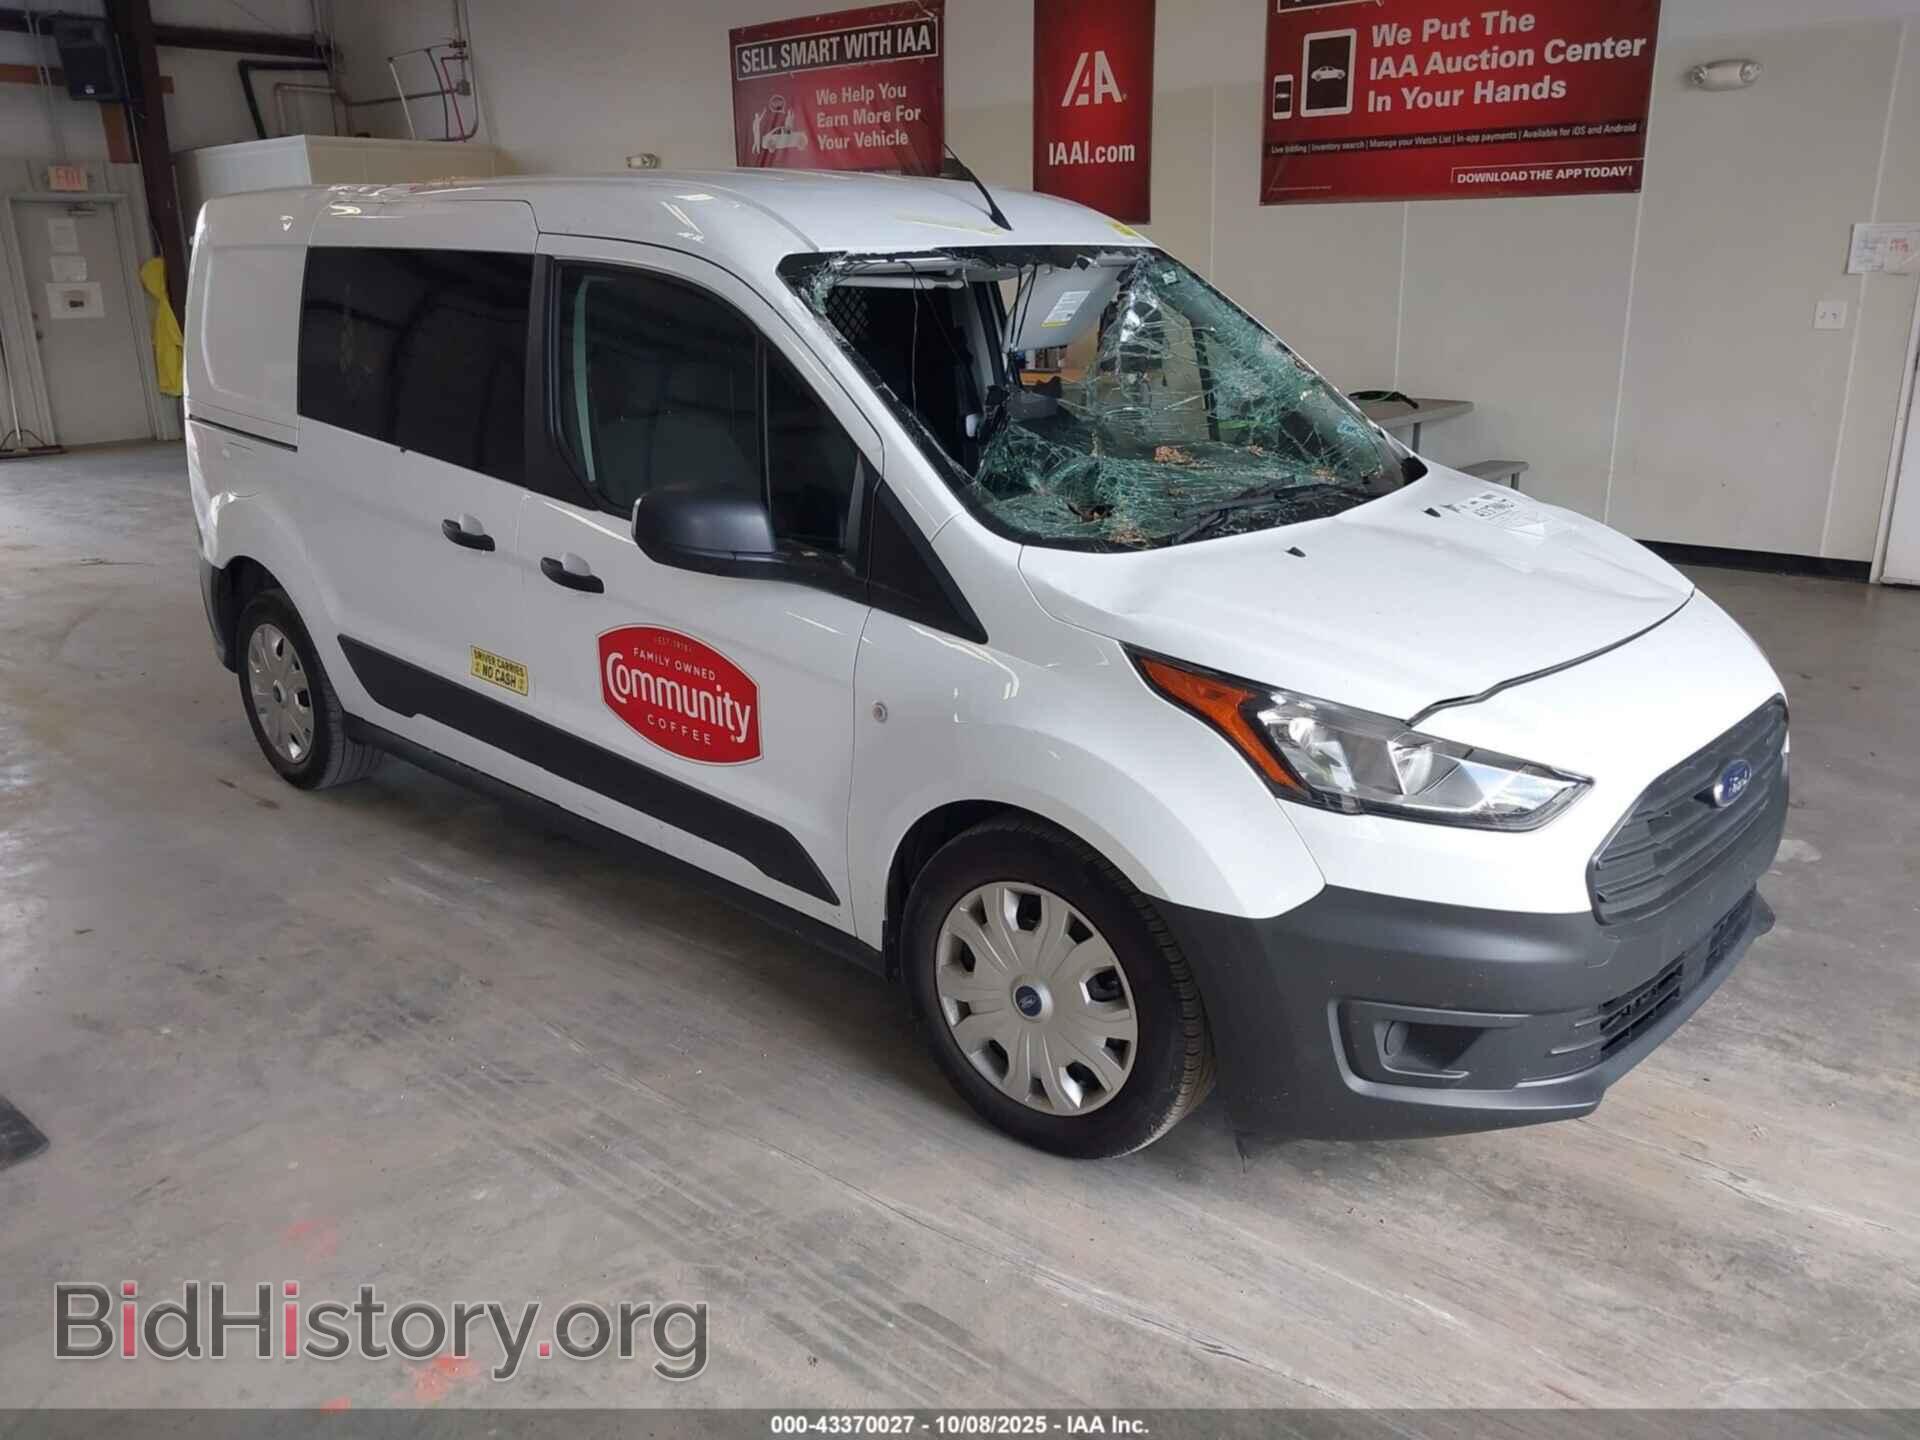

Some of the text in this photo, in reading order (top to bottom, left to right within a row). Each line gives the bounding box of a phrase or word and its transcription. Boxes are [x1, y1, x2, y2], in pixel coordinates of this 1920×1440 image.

[1372, 10, 1536, 48] We Put The
[742, 24, 932, 74] SELL SMART WITH IAA
[1369, 36, 1647, 81] IAA Auction Center
[816, 82, 907, 106] We Help You
[1367, 74, 1567, 113] In Your Hands
[816, 105, 921, 128] Earn More For
[1523, 128, 1558, 139] Available
[1559, 127, 1571, 137] for
[1587, 125, 1602, 134] and
[1603, 122, 1637, 134] Android
[817, 128, 909, 150] Your Vehicle
[1048, 140, 1136, 166] IAAI.com
[1457, 165, 1633, 184] DOWNLOAD THE APP TODAY!
[482, 663, 517, 689] NO CASH
[633, 647, 716, 681] FAMILY OWNED
[606, 652, 751, 744] Community
[647, 714, 712, 745] COFFEE
